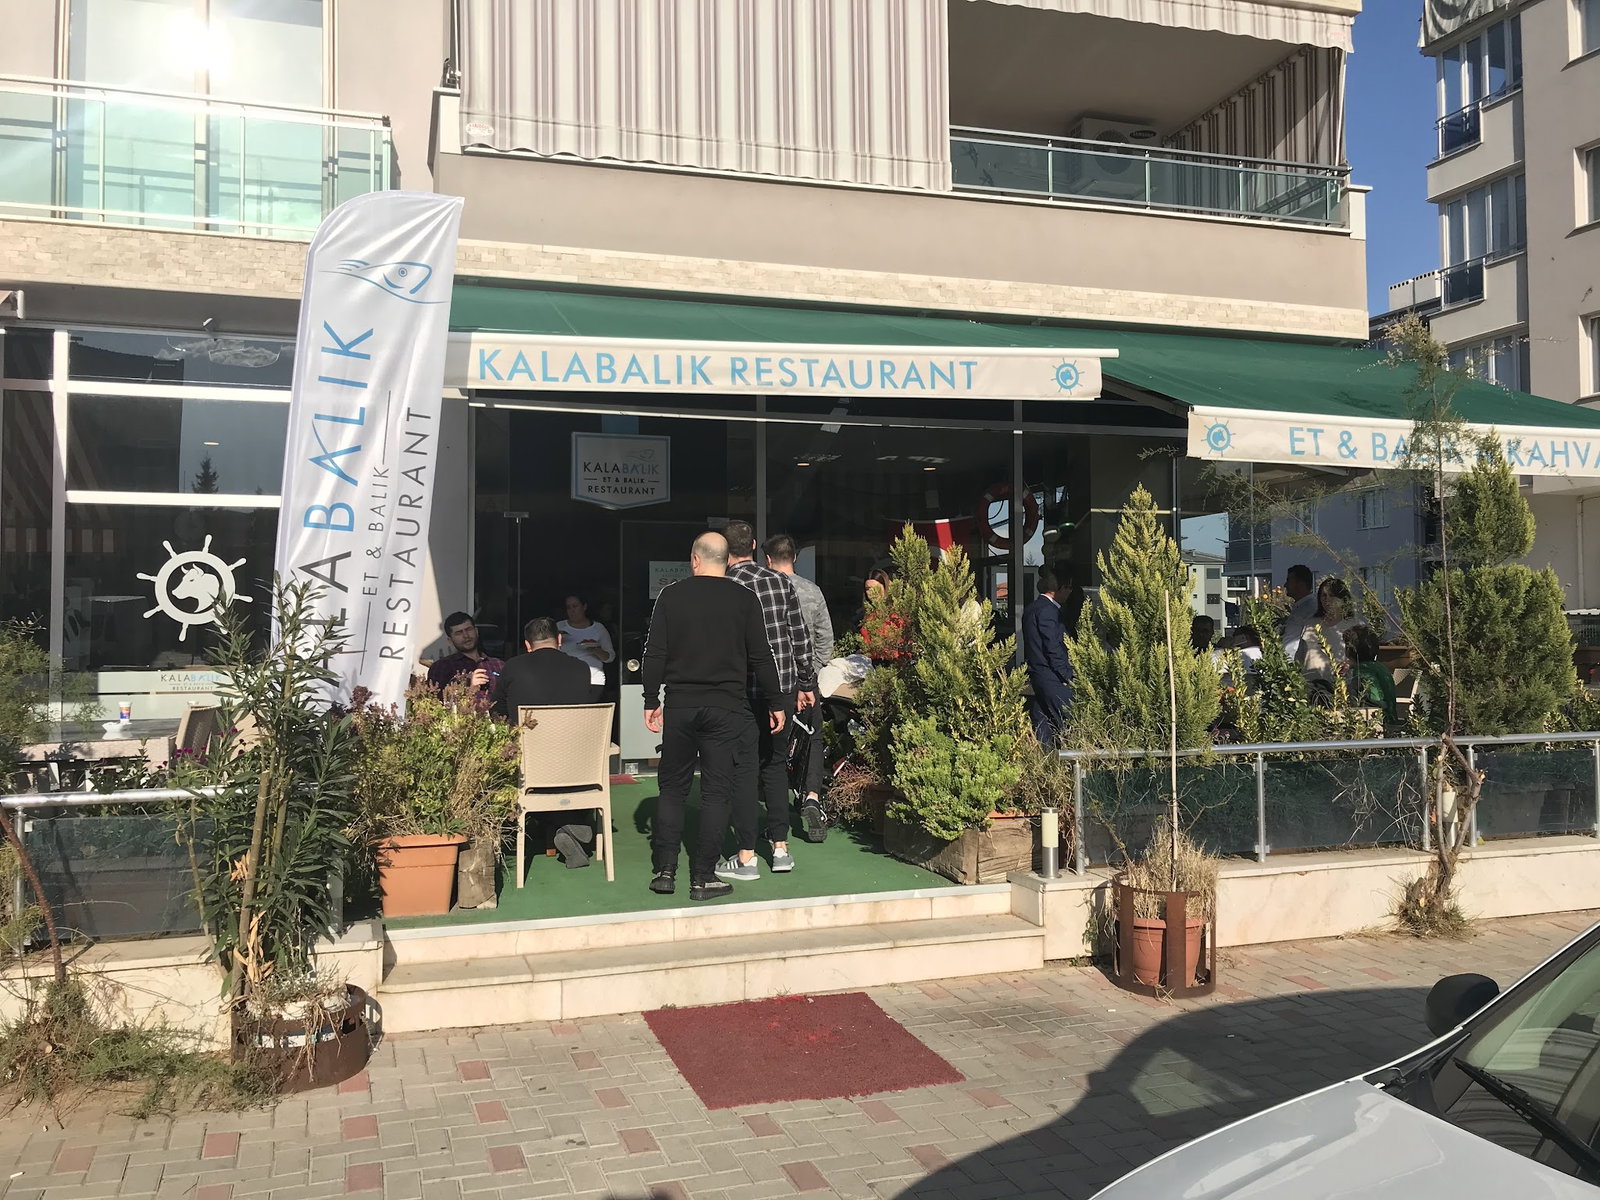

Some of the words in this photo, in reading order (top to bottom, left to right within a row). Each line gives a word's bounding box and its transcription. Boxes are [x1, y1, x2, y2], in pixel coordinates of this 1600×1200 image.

[478, 348, 714, 386] KALABALIK
[730, 356, 978, 390] RESTAURANT
[1289, 426, 1325, 456] ET
[1337, 430, 1358, 460] &
[583, 461, 660, 475] KALABALIK
[368, 466, 389, 532] BALIK
[588, 485, 656, 495] RESTAURANT
[379, 407, 432, 660] RESTAURANT
[366, 546, 382, 559] &
[362, 572, 379, 596] ET
